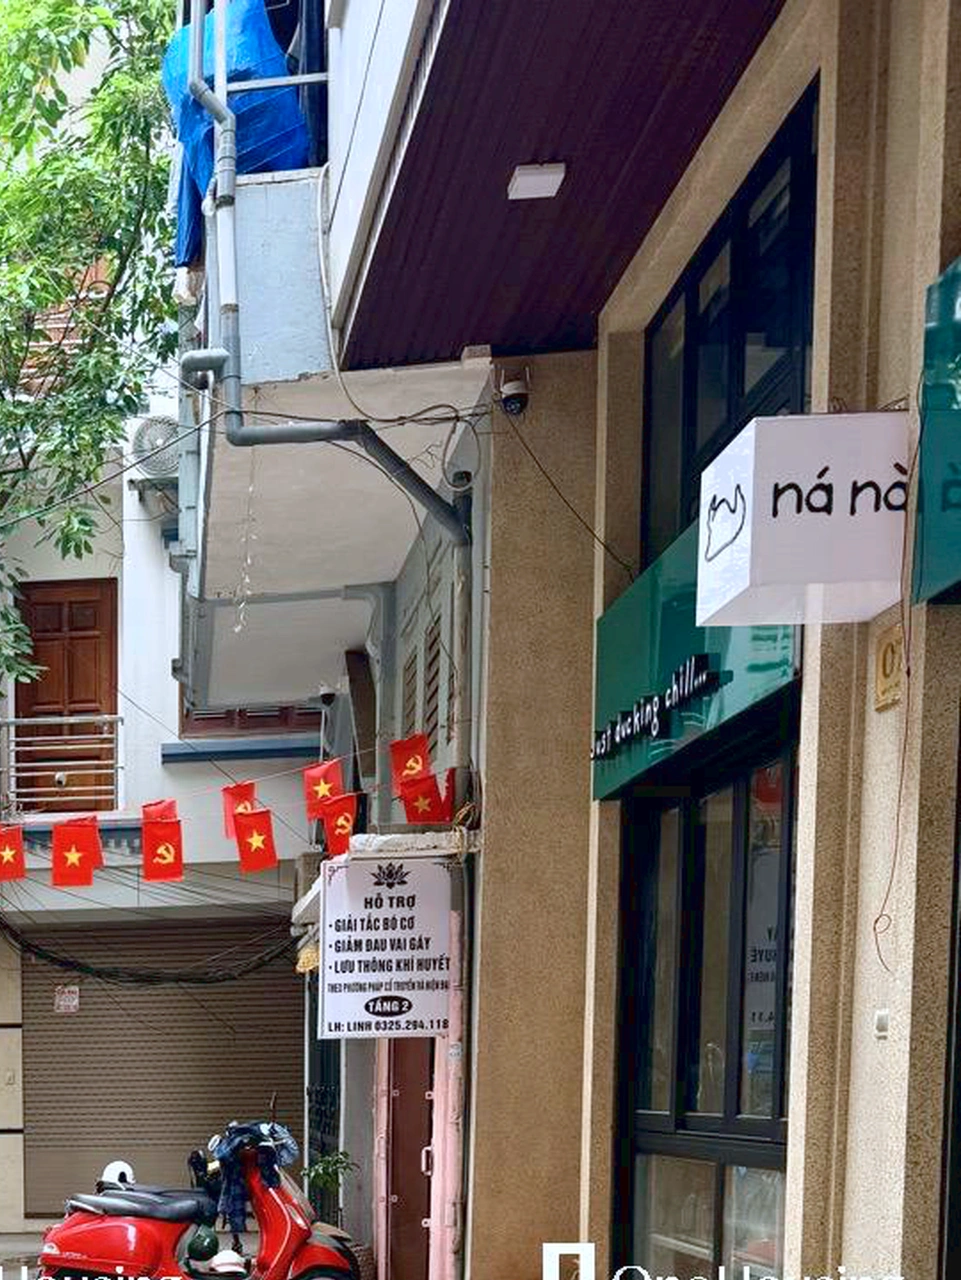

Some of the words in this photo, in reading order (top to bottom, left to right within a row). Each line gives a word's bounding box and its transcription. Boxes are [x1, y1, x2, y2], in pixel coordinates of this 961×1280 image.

[772, 466, 834, 518] ná
[388, 894, 416, 910] TRỢ
[334, 914, 357, 932] GIẢI
[400, 915, 415, 930] CƠ
[334, 935, 362, 953] GIẢM
[365, 938, 388, 952] ĐAU
[390, 938, 407, 951] VAI
[409, 935, 431, 951] GÁY
[334, 958, 355, 974] LƯU
[358, 956, 393, 972] THÔNG
[395, 955, 414, 972] KHÍ
[417, 953, 450, 971] HUYẾT
[368, 998, 399, 1012] TẦNG
[401, 1001, 410, 1012] 2
[328, 1022, 345, 1032] LH:
[347, 1021, 372, 1032] LINH
